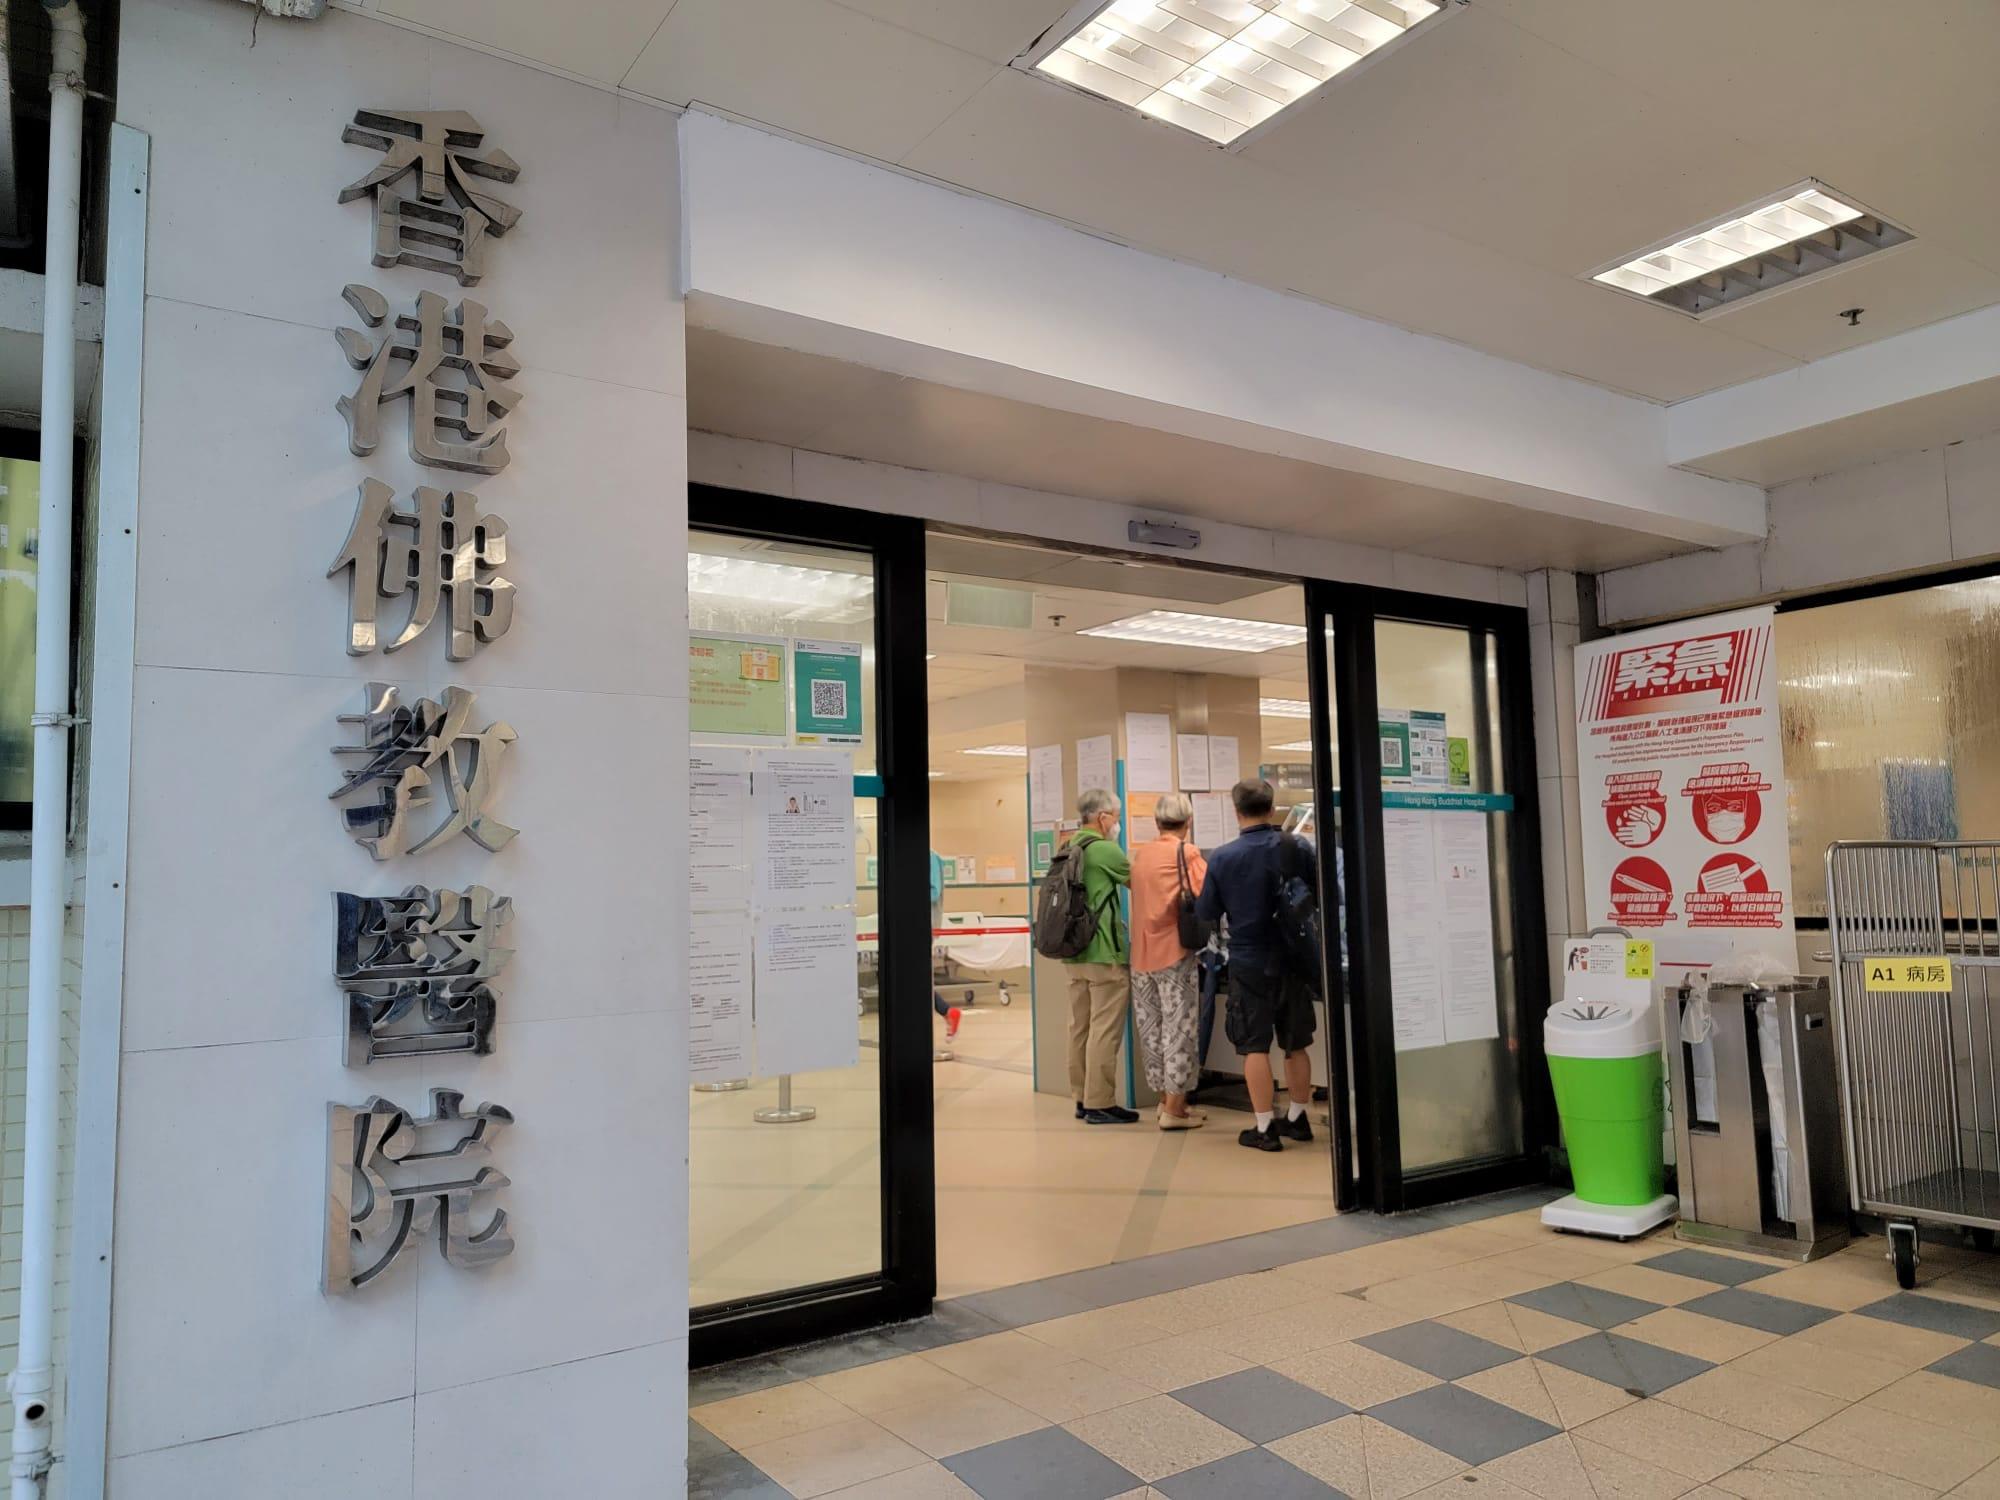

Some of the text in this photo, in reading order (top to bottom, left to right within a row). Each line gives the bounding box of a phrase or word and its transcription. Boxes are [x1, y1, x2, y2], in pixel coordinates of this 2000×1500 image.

[1614, 635, 1734, 692] 緊急
[320, 108, 524, 1298] 香港佛教醫院
[1872, 965, 1946, 983] A1 病房
